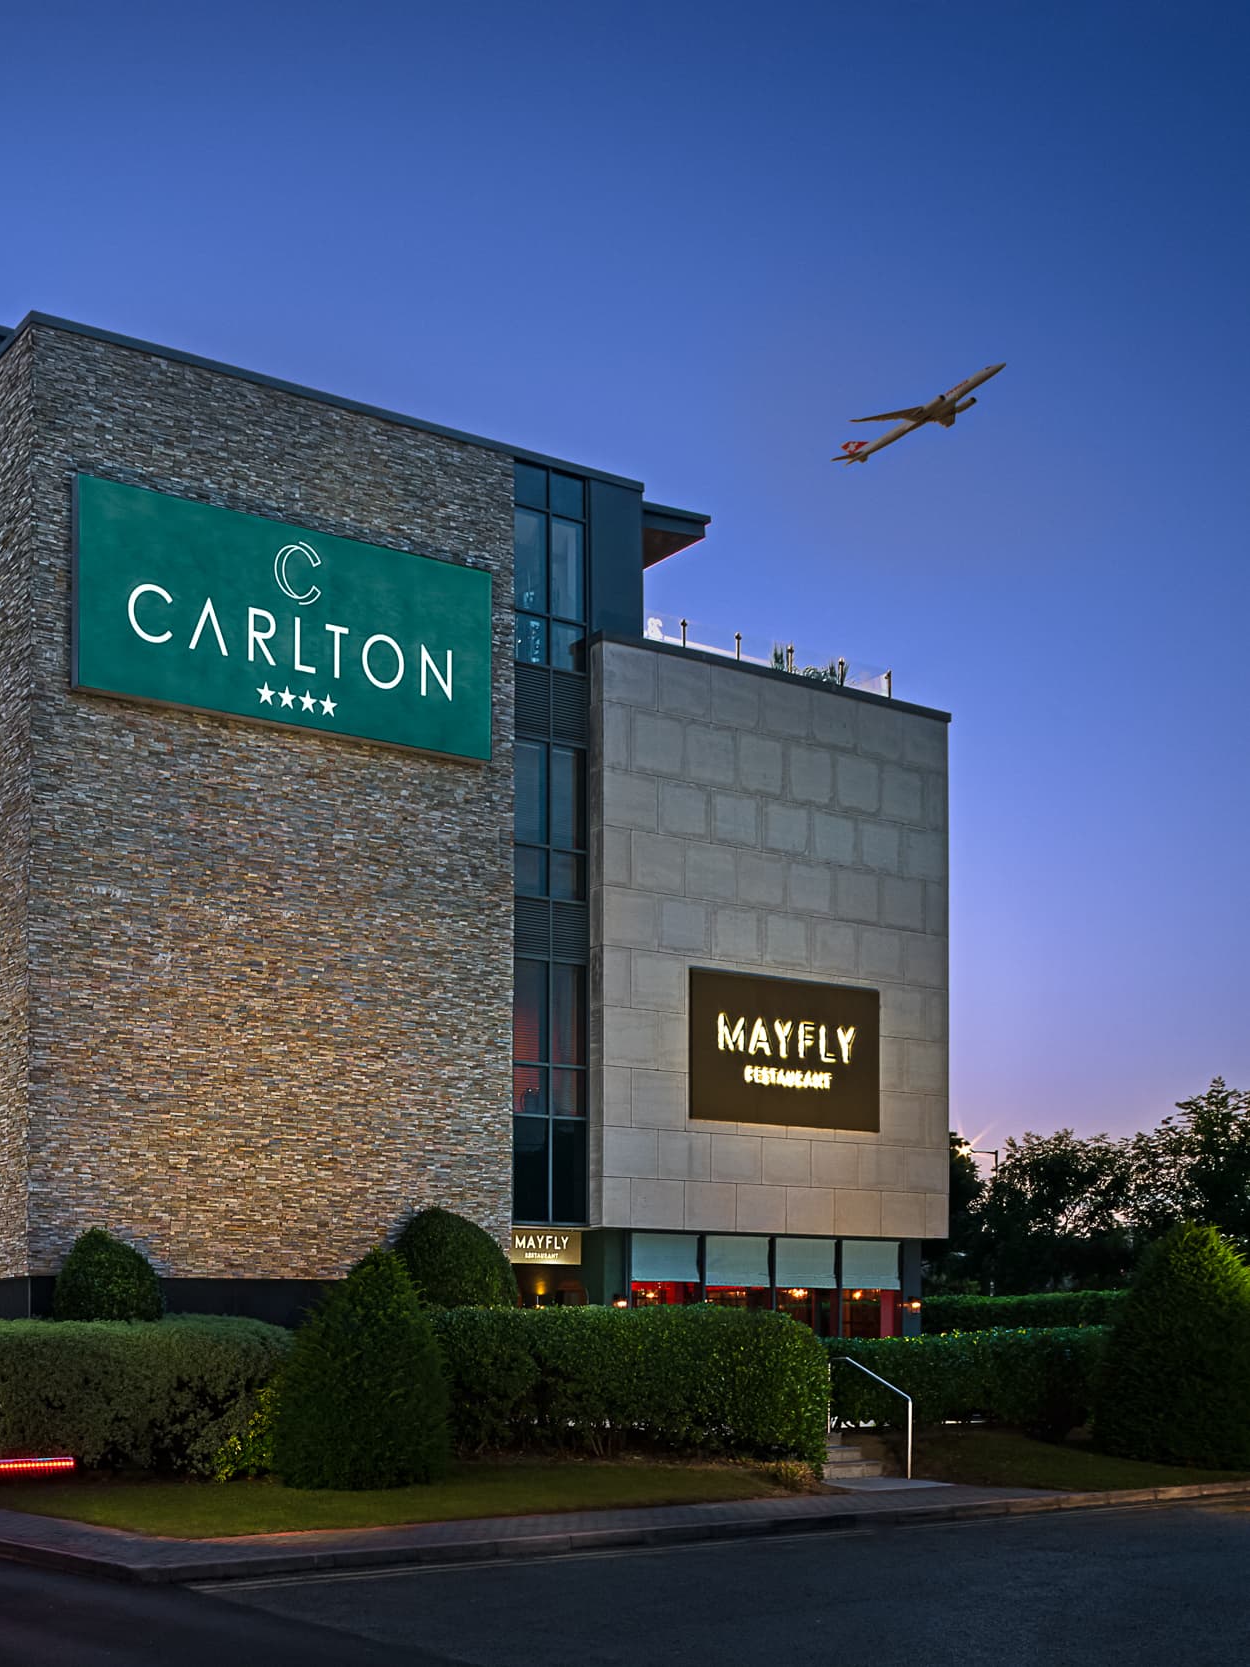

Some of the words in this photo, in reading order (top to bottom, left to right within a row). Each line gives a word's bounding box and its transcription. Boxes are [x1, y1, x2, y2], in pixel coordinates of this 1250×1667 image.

[127, 583, 453, 702] CARLTON
[716, 1011, 856, 1064] MAYFLY
[744, 1064, 833, 1090] RESTAURANT
[515, 1234, 569, 1250] MAYFLY
